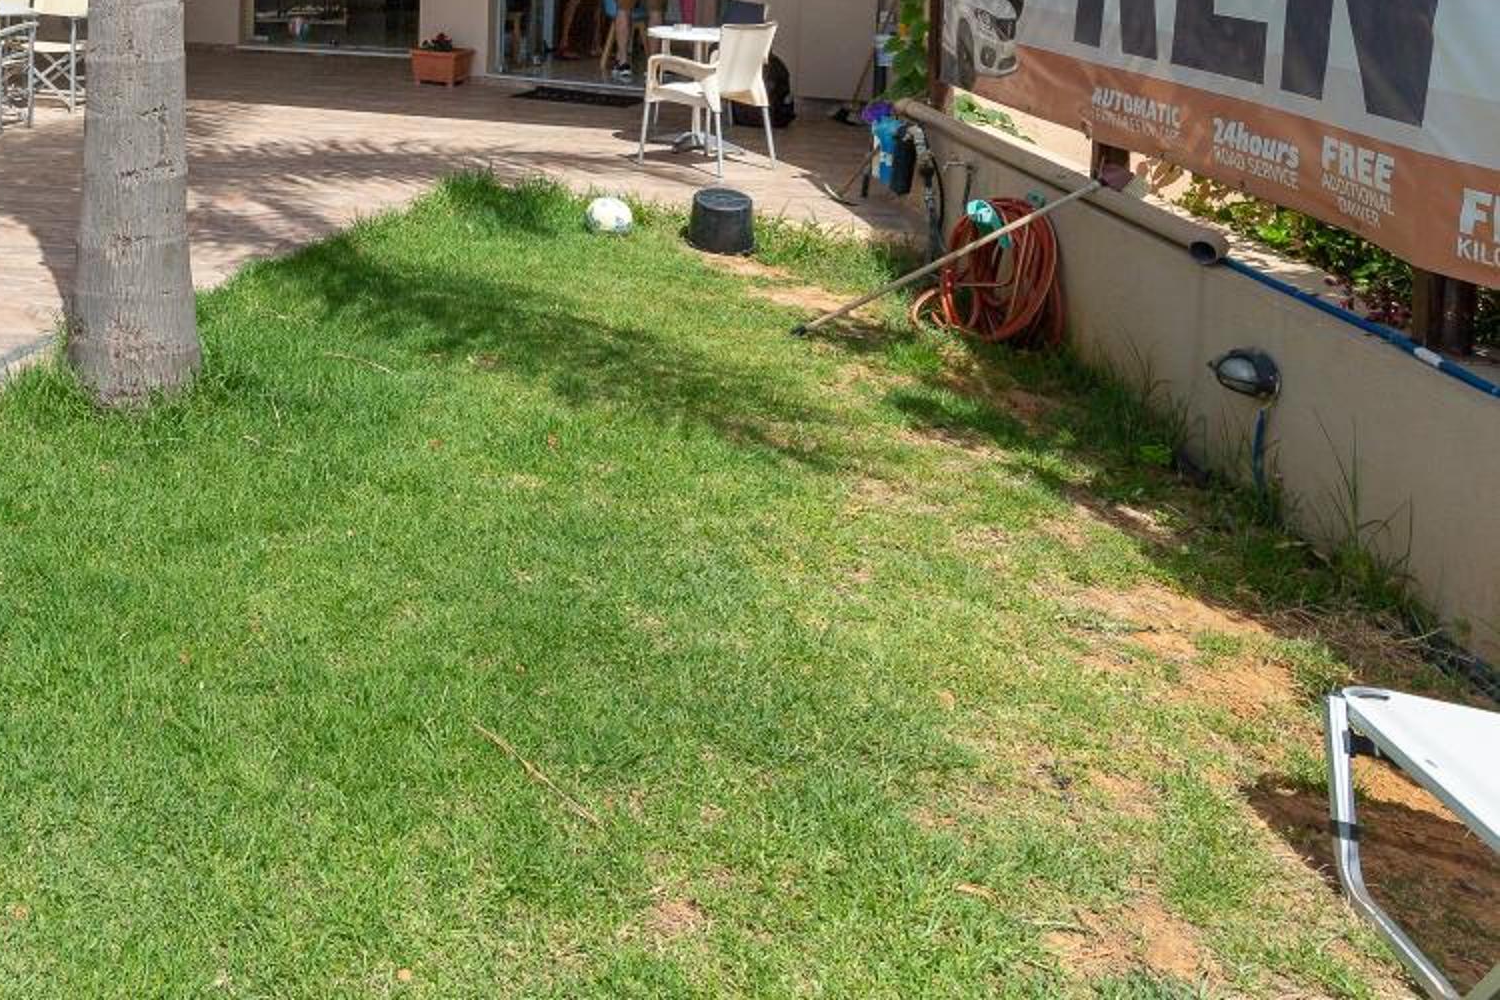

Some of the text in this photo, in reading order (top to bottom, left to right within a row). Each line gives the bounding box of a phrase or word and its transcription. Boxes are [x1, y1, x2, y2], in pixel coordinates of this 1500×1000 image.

[1091, 87, 1182, 129] AUTOMATIC
[1213, 117, 1299, 169] 24hours
[1321, 134, 1396, 195] FREE
